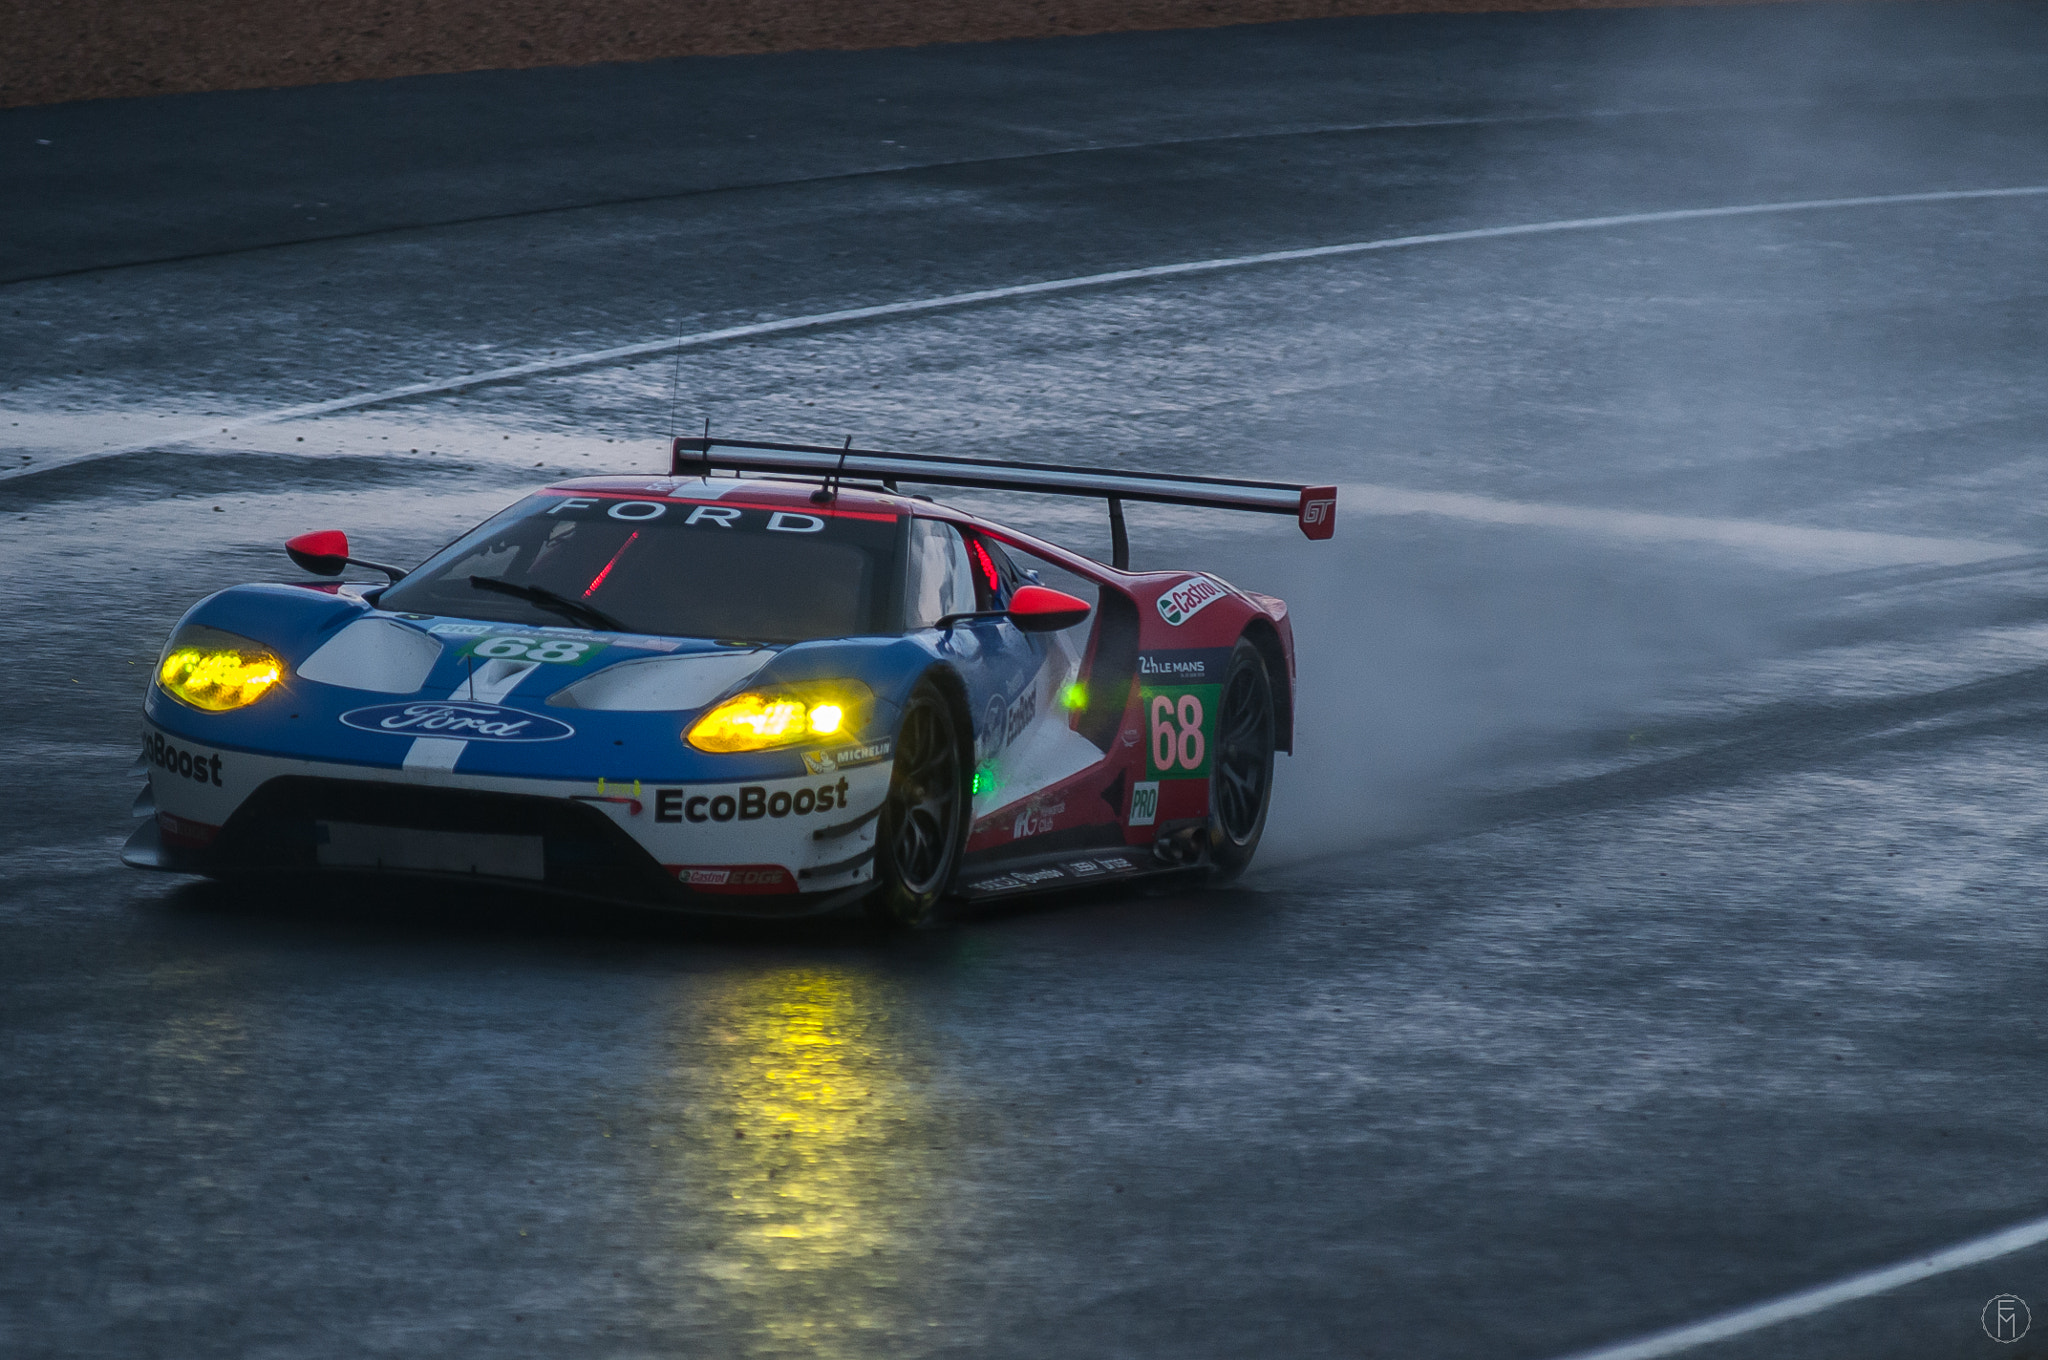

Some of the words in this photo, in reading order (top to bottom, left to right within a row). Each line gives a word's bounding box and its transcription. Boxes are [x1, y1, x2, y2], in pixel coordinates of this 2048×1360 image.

[546, 497, 825, 533] FORD
[1303, 498, 1336, 526] GT
[1172, 580, 1221, 614] Castrol
[473, 636, 590, 662] 68
[1160, 662, 1171, 673] LE
[1173, 661, 1205, 673] MANS
[380, 704, 531, 737] Ford
[1151, 694, 1205, 771] 68
[142, 731, 223, 788] oBoost
[837, 743, 890, 763] MICHELIN
[655, 776, 849, 823] EcoBoost
[1132, 788, 1157, 819] PRO
[689, 870, 726, 884] Castrol
[729, 870, 784, 885] EDGE
